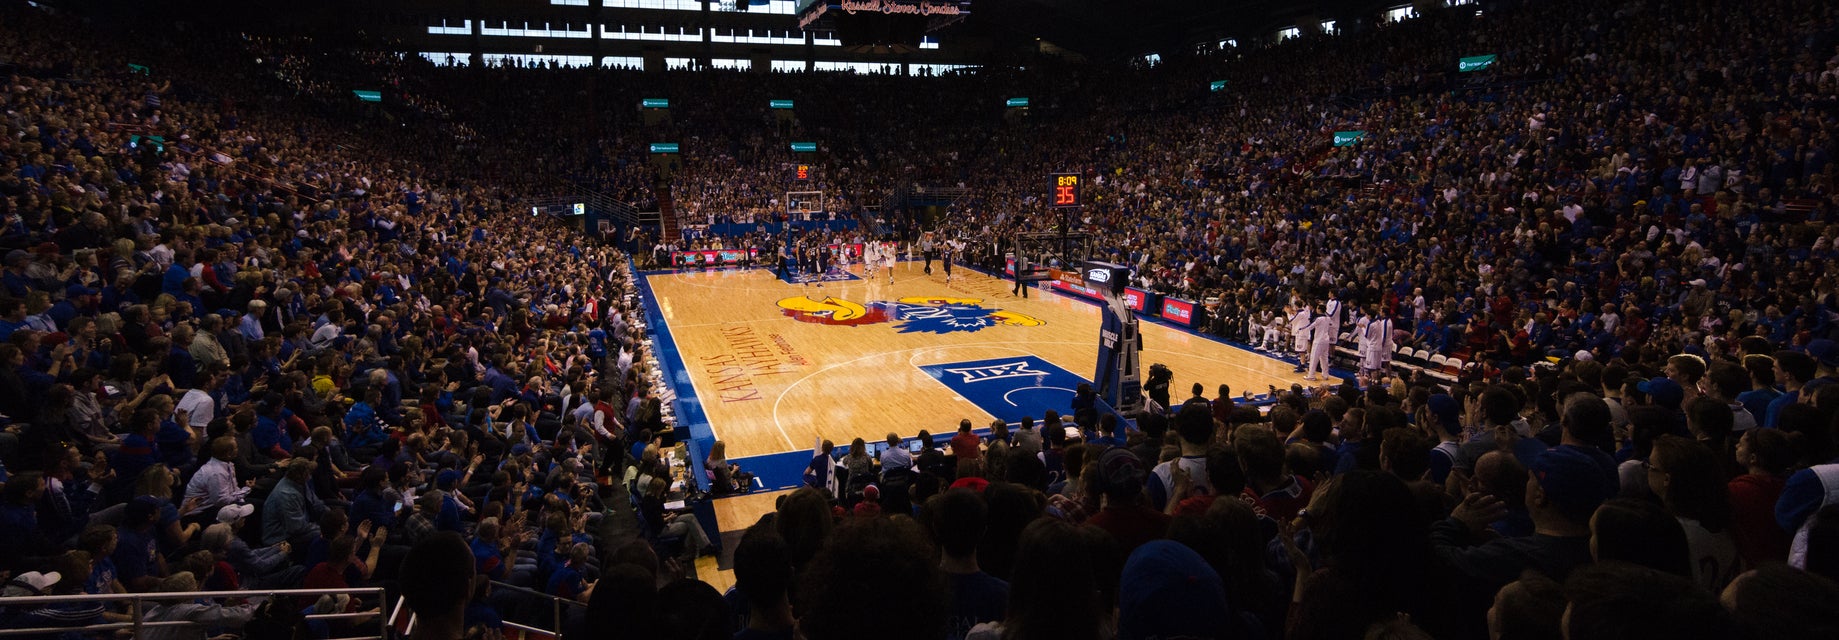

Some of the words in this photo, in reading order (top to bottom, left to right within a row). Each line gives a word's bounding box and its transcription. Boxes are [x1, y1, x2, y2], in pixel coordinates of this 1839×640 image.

[841, 0, 881, 15] Russell
[882, 0, 920, 15] Stover
[920, 1, 960, 16] Candies
[1057, 176, 1078, 186] 8:09
[1056, 187, 1075, 204] 35
[719, 327, 799, 377] JAYHAWKS
[700, 354, 763, 403] KANSAS
